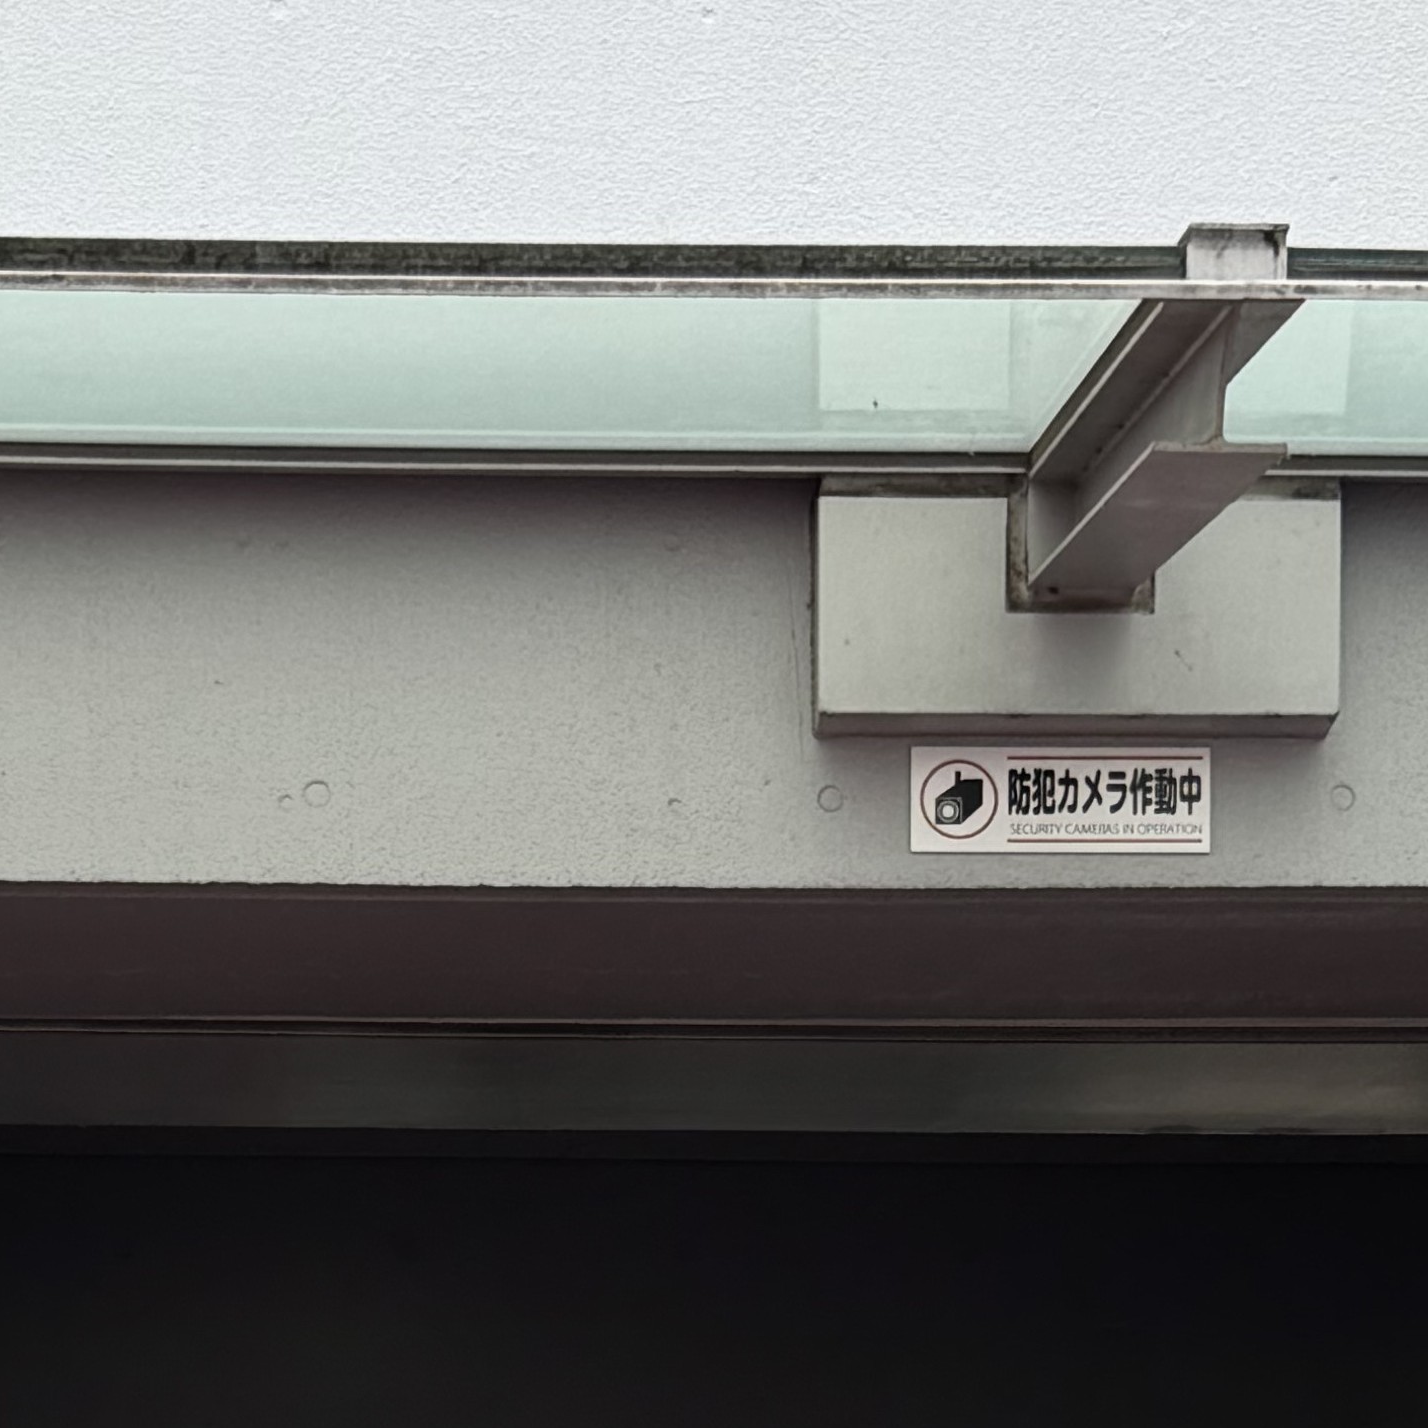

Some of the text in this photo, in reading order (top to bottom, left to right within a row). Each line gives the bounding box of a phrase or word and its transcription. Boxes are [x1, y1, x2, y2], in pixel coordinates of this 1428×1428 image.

[1008, 767, 1202, 816] 防犯カメラ作動中
[1011, 824, 1203, 836] SECURITY CAMERAS IN OPERATION
